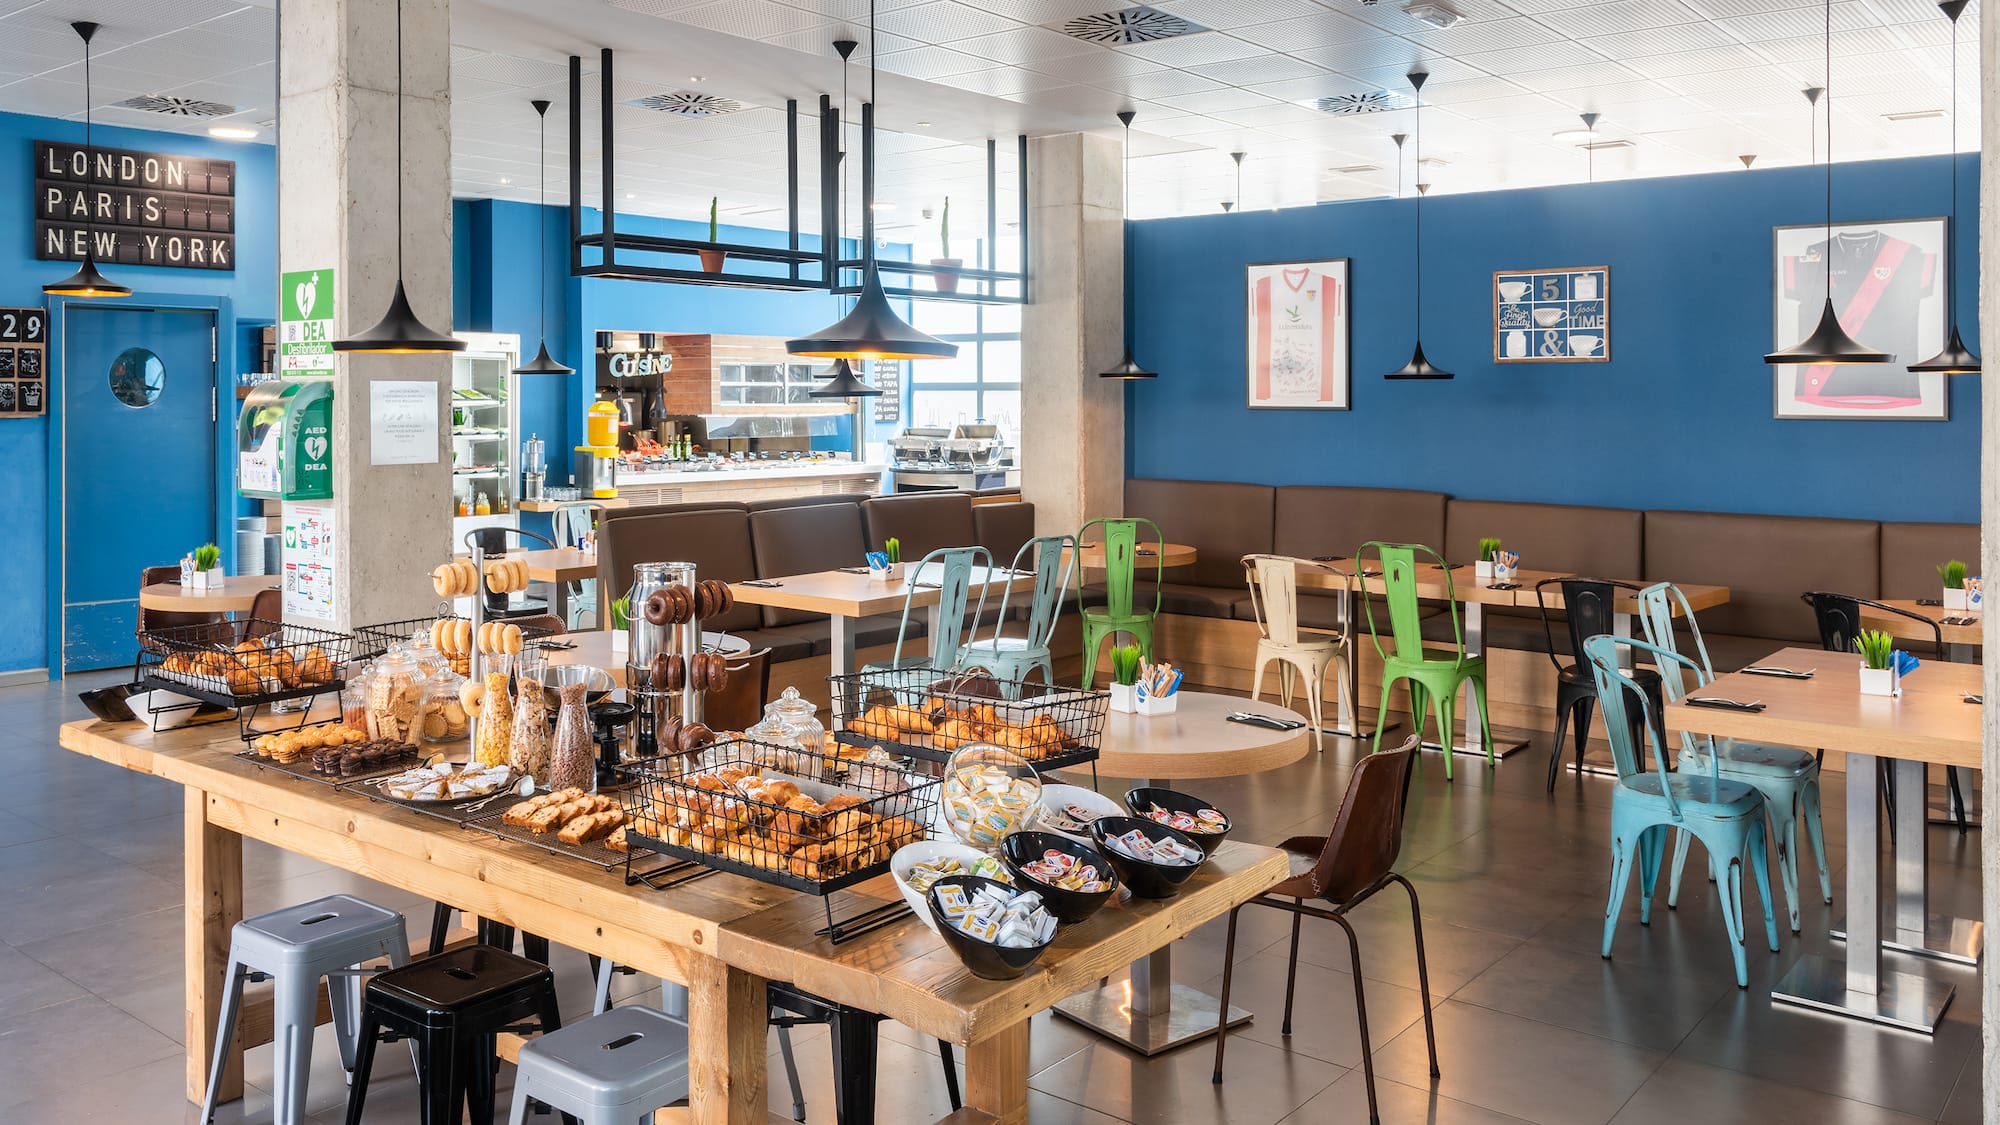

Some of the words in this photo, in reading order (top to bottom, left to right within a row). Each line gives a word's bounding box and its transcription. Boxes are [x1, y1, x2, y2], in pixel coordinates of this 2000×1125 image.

[48, 148, 183, 186] LONDON
[47, 188, 160, 221] PARIS
[47, 228, 116, 257] NEW
[145, 235, 226, 264] YORK
[1542, 278, 1560, 300] 5
[1574, 301, 1600, 316] Good
[303, 321, 326, 341] DEA
[1569, 315, 1604, 328] TIME
[287, 342, 327, 355] Desfibrilador
[304, 427, 327, 435] AED
